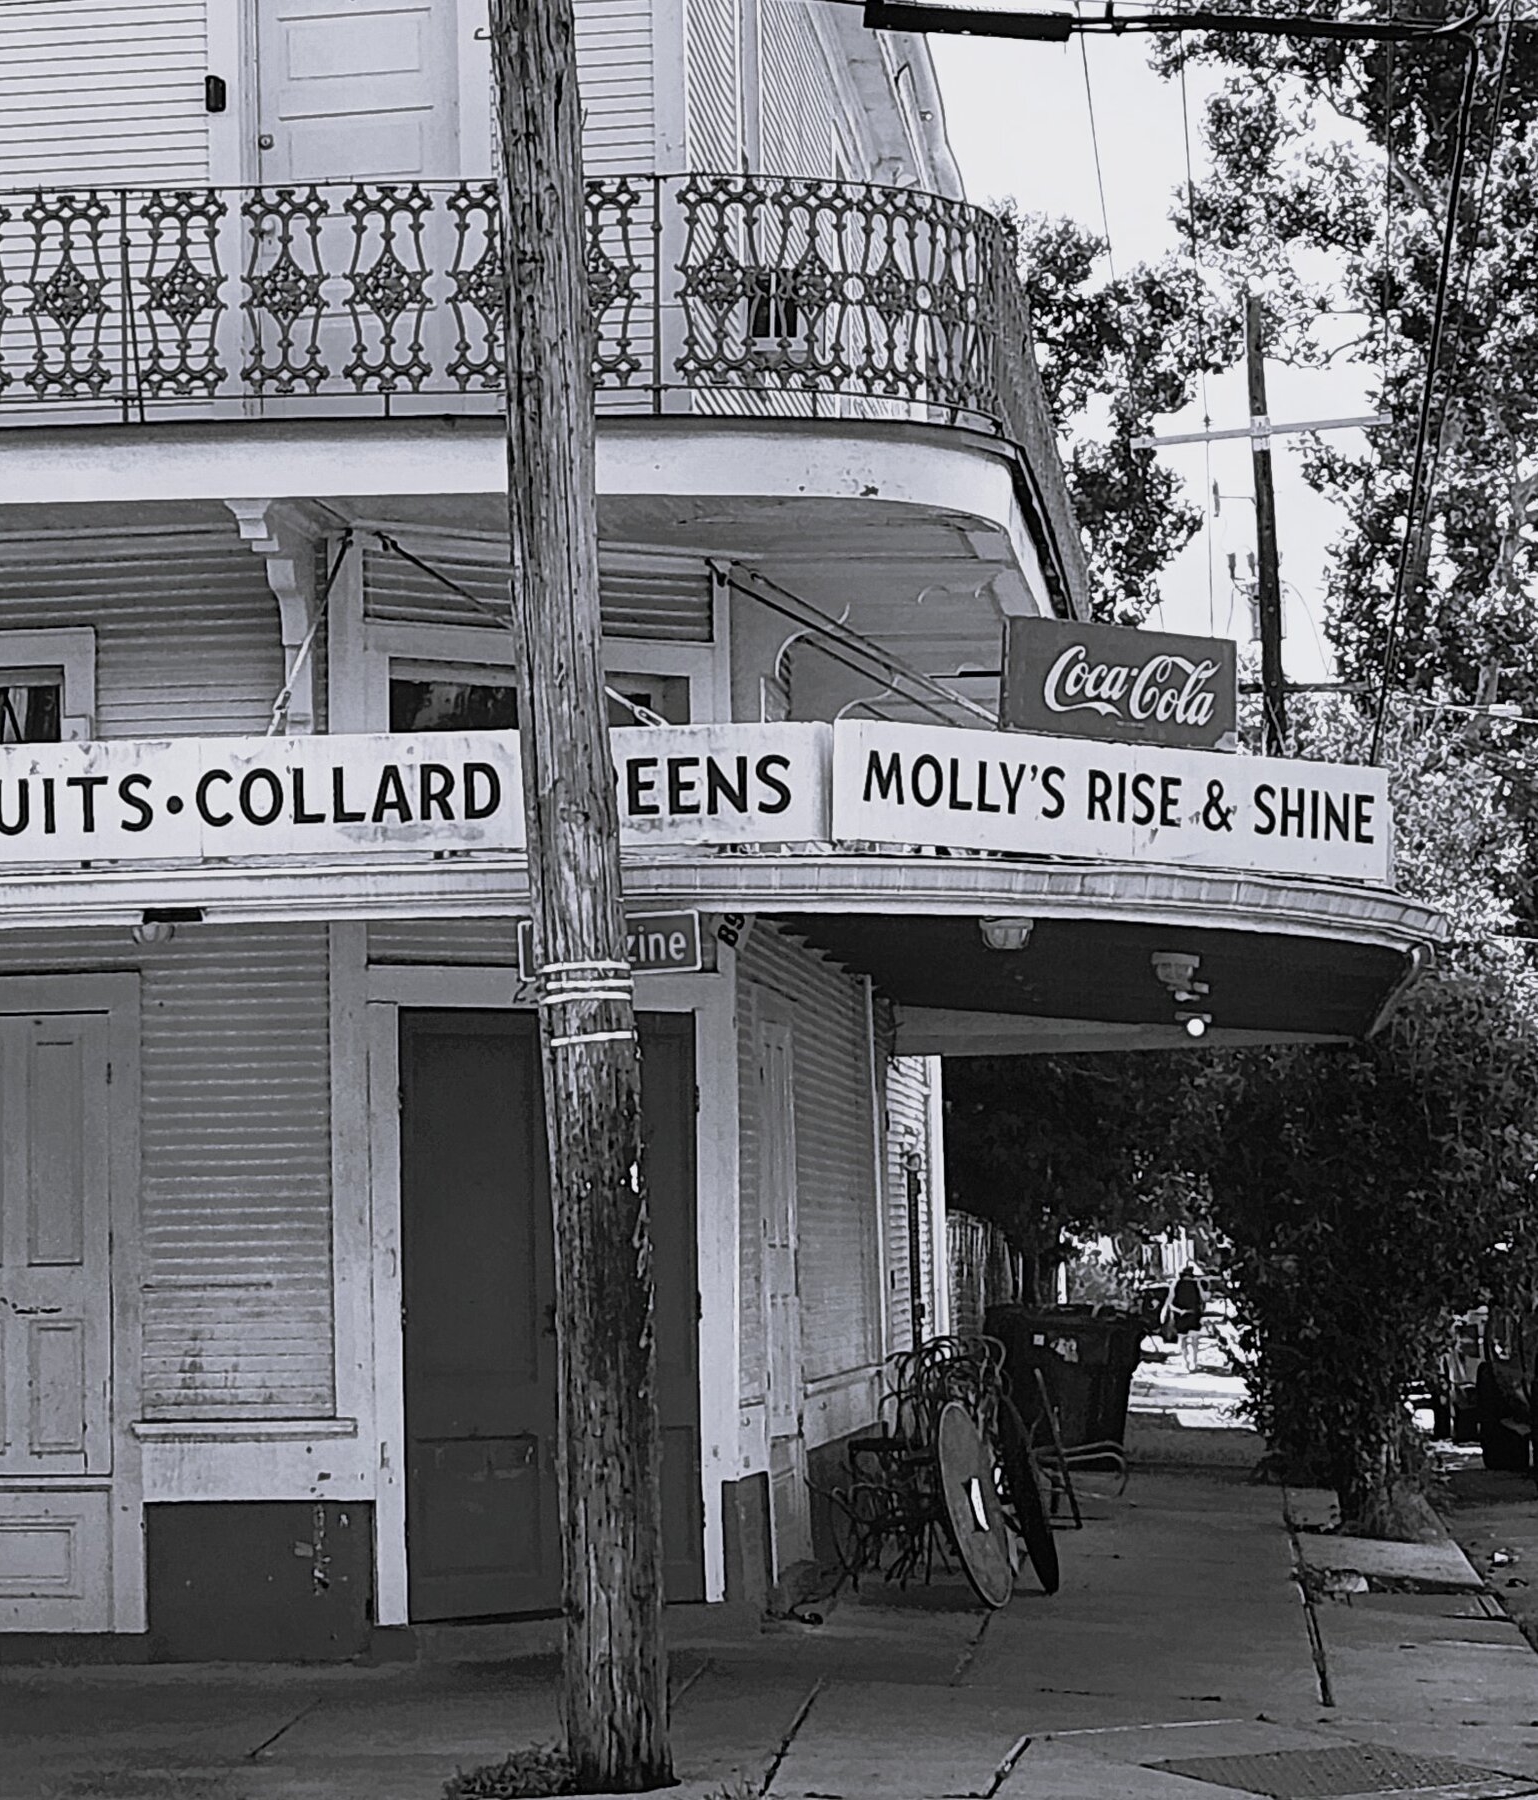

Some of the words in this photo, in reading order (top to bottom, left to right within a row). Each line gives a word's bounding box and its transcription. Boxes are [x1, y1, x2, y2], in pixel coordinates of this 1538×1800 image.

[1044, 645, 1221, 726] Coca-Cola
[195, 762, 501, 828] COLLARD
[613, 754, 792, 816] EENS
[863, 750, 1066, 819] MOLLY'S
[1087, 769, 1182, 828] RISE
[1202, 779, 1238, 832] &
[1254, 783, 1374, 845] SHINE
[626, 925, 687, 962] zine
